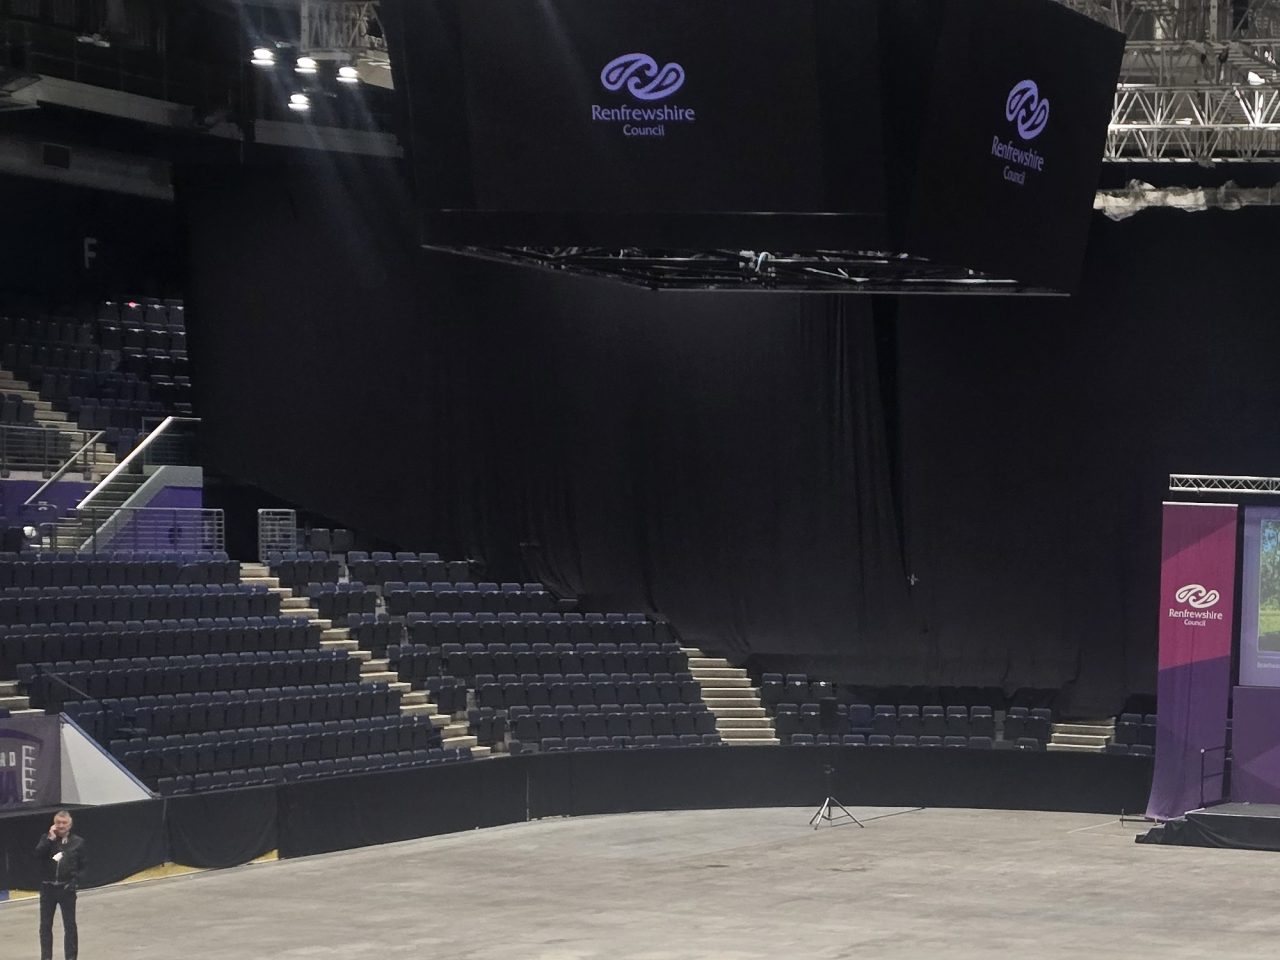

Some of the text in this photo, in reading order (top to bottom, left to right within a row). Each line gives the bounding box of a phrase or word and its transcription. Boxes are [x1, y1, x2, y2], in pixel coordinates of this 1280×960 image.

[591, 104, 695, 121] Renfrewshire
[623, 124, 665, 136] Council
[991, 135, 1044, 171] Renfrewshire
[1003, 165, 1026, 185] Council
[84, 237, 97, 269] F
[1169, 608, 1223, 620] Renfrewshire
[1183, 619, 1206, 627] Council
